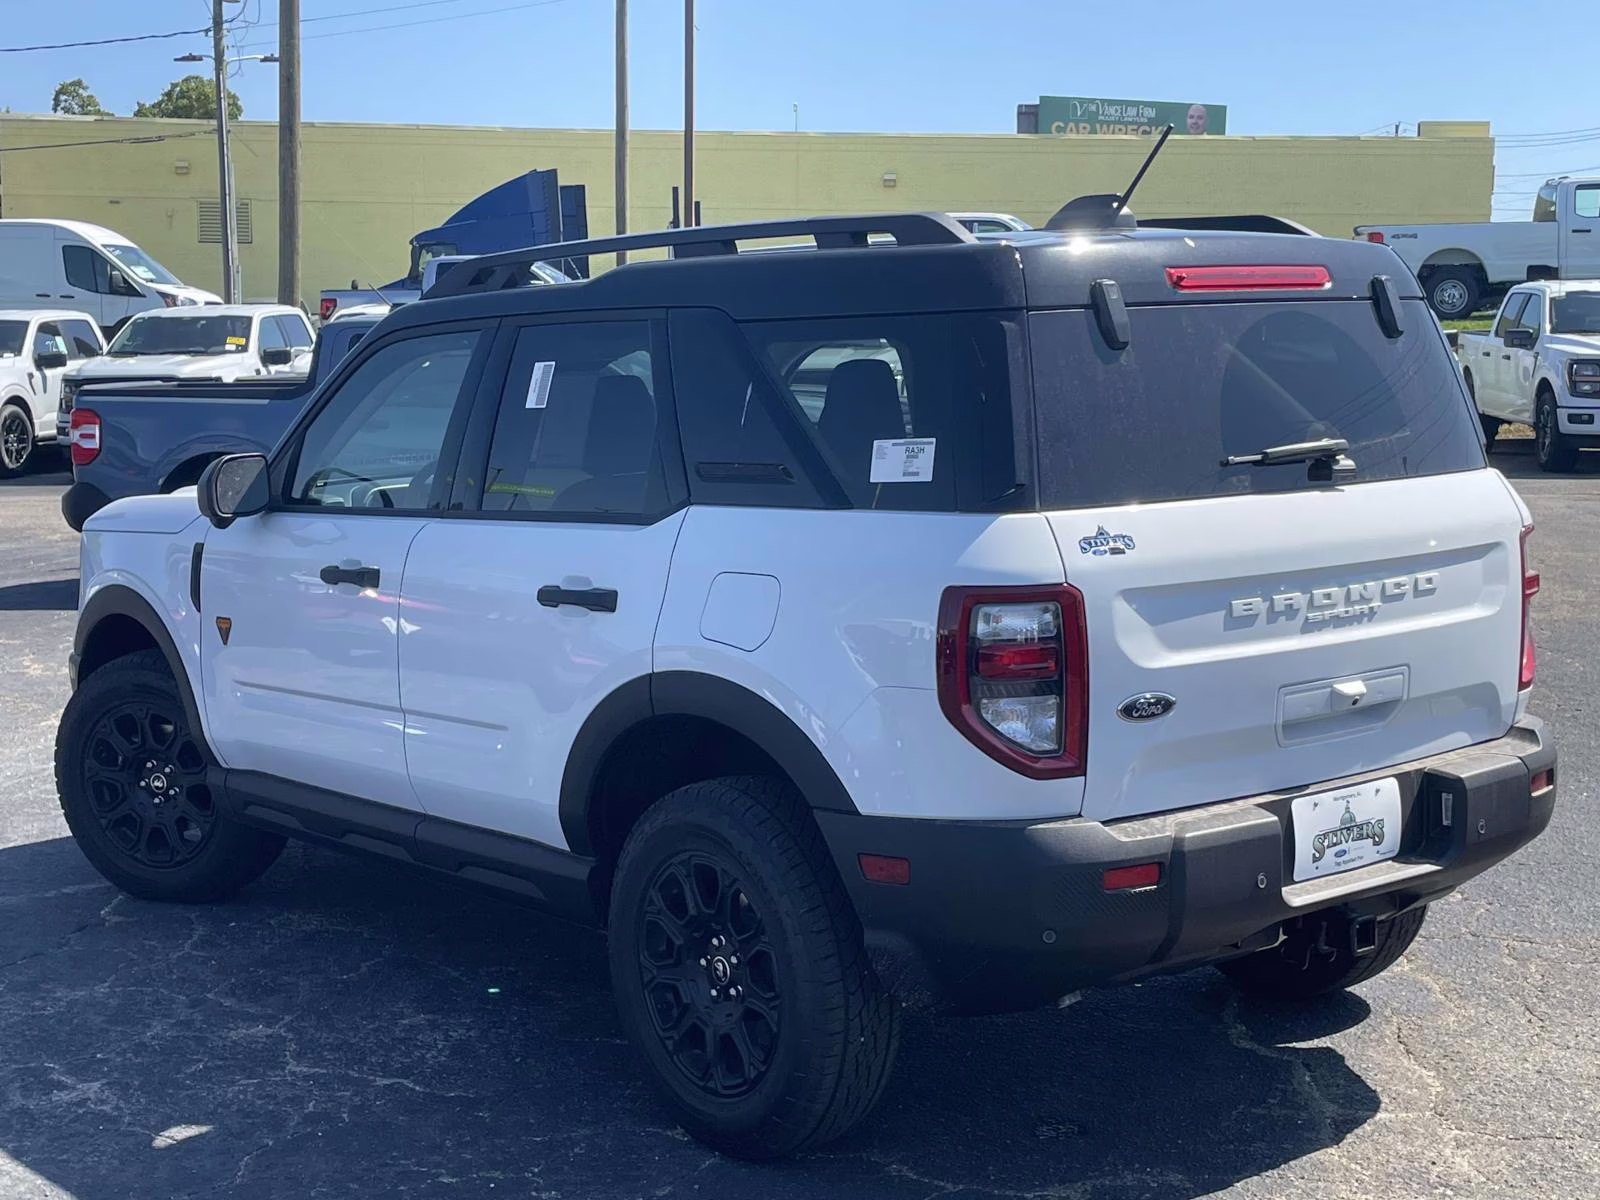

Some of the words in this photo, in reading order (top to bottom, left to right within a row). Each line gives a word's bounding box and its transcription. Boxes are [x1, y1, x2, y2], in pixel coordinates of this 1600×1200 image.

[1096, 100, 1122, 117] VANCE
[1123, 105, 1138, 118] LAW
[1139, 105, 1156, 119] FIRM
[1051, 121, 1090, 135] CAR
[905, 446, 925, 455] RA3H
[1079, 534, 1136, 555] STIVERS
[1231, 572, 1440, 618] BRONCO
[1306, 602, 1383, 623] SPORT
[1131, 698, 1165, 718] Ford
[1311, 818, 1385, 865] STIVERS
